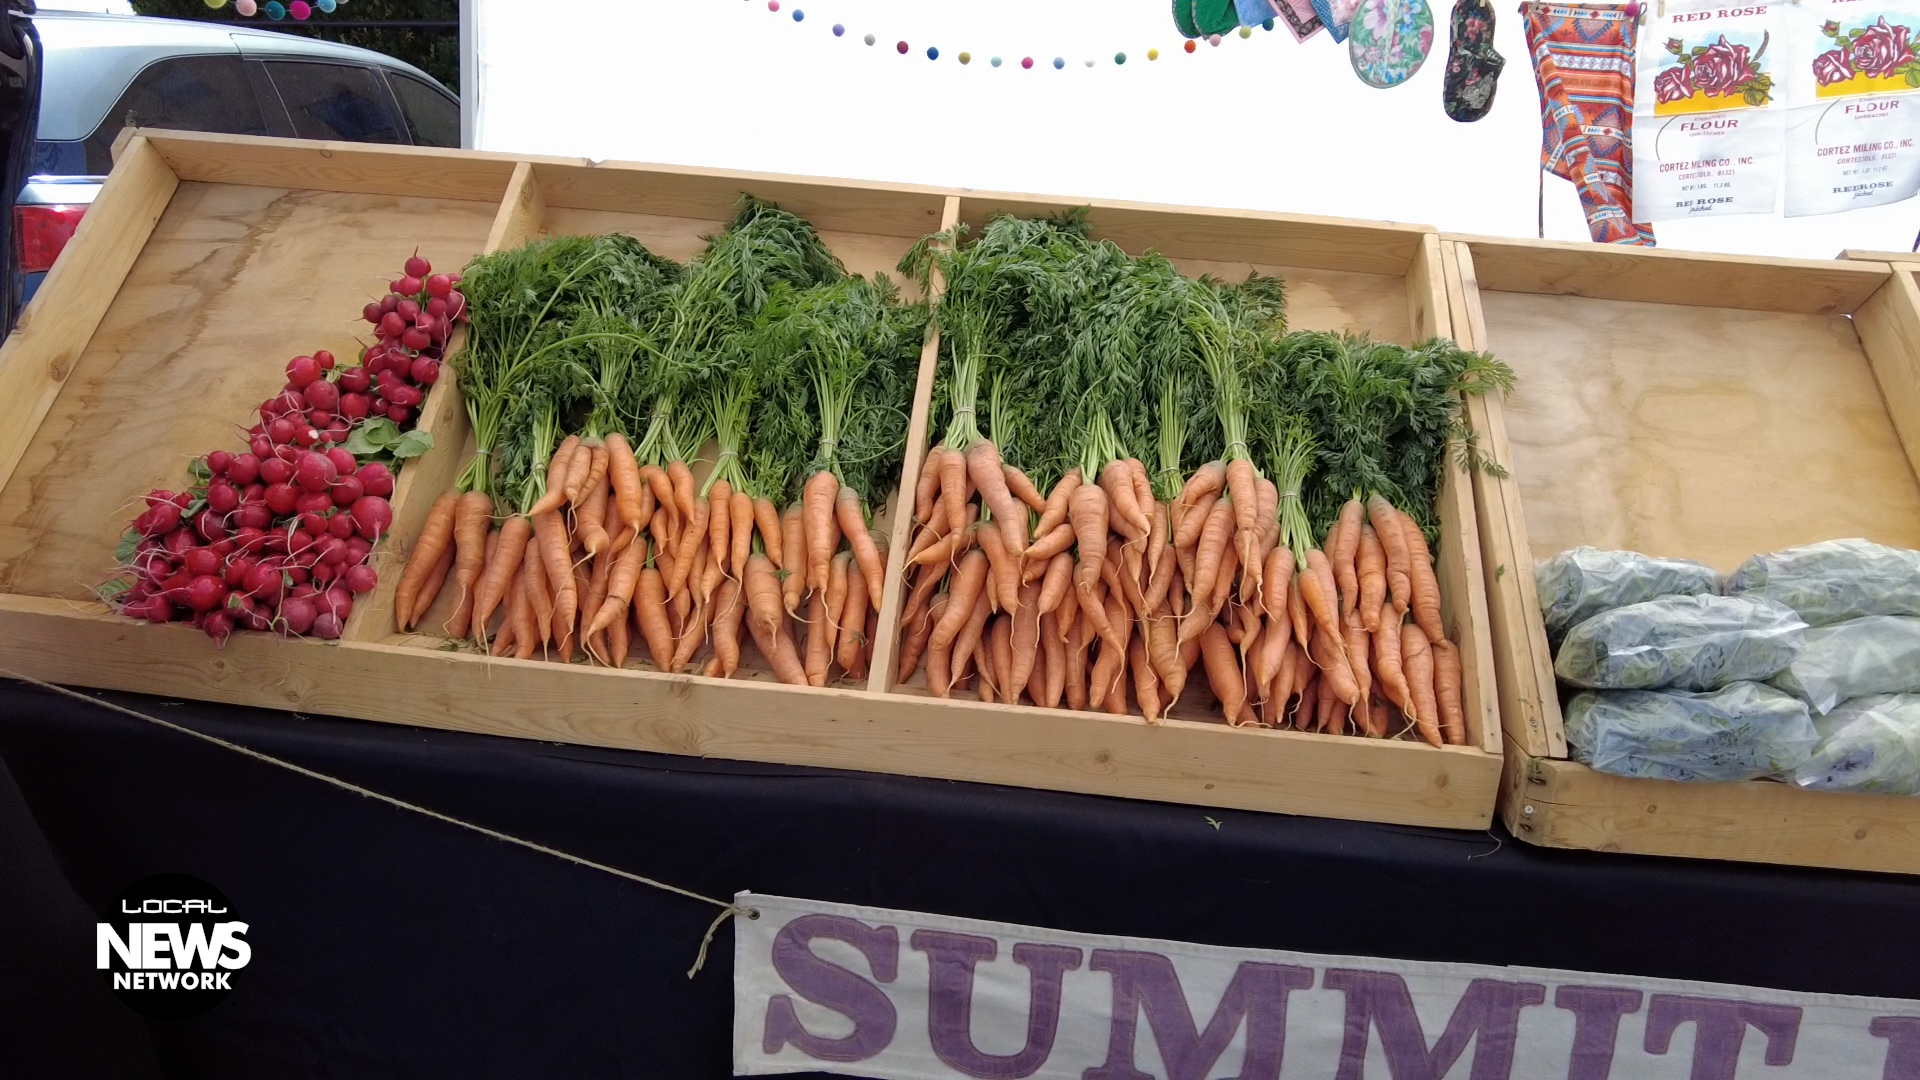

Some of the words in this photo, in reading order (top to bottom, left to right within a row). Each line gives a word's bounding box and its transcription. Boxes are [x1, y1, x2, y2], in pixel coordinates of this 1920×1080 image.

[1672, 11, 1711, 23] RED
[1717, 5, 1767, 18] ROSE
[1845, 100, 1900, 114] FLOUR
[1680, 119, 1739, 131] FLOUR
[1817, 146, 1851, 157] CORTEZ
[1900, 138, 1915, 148] INC.
[1659, 162, 1689, 173] CORTEZ
[1738, 156, 1756, 165] INC.
[1697, 196, 1734, 205] ROSE
[762, 913, 1803, 1080] SUMMIT
